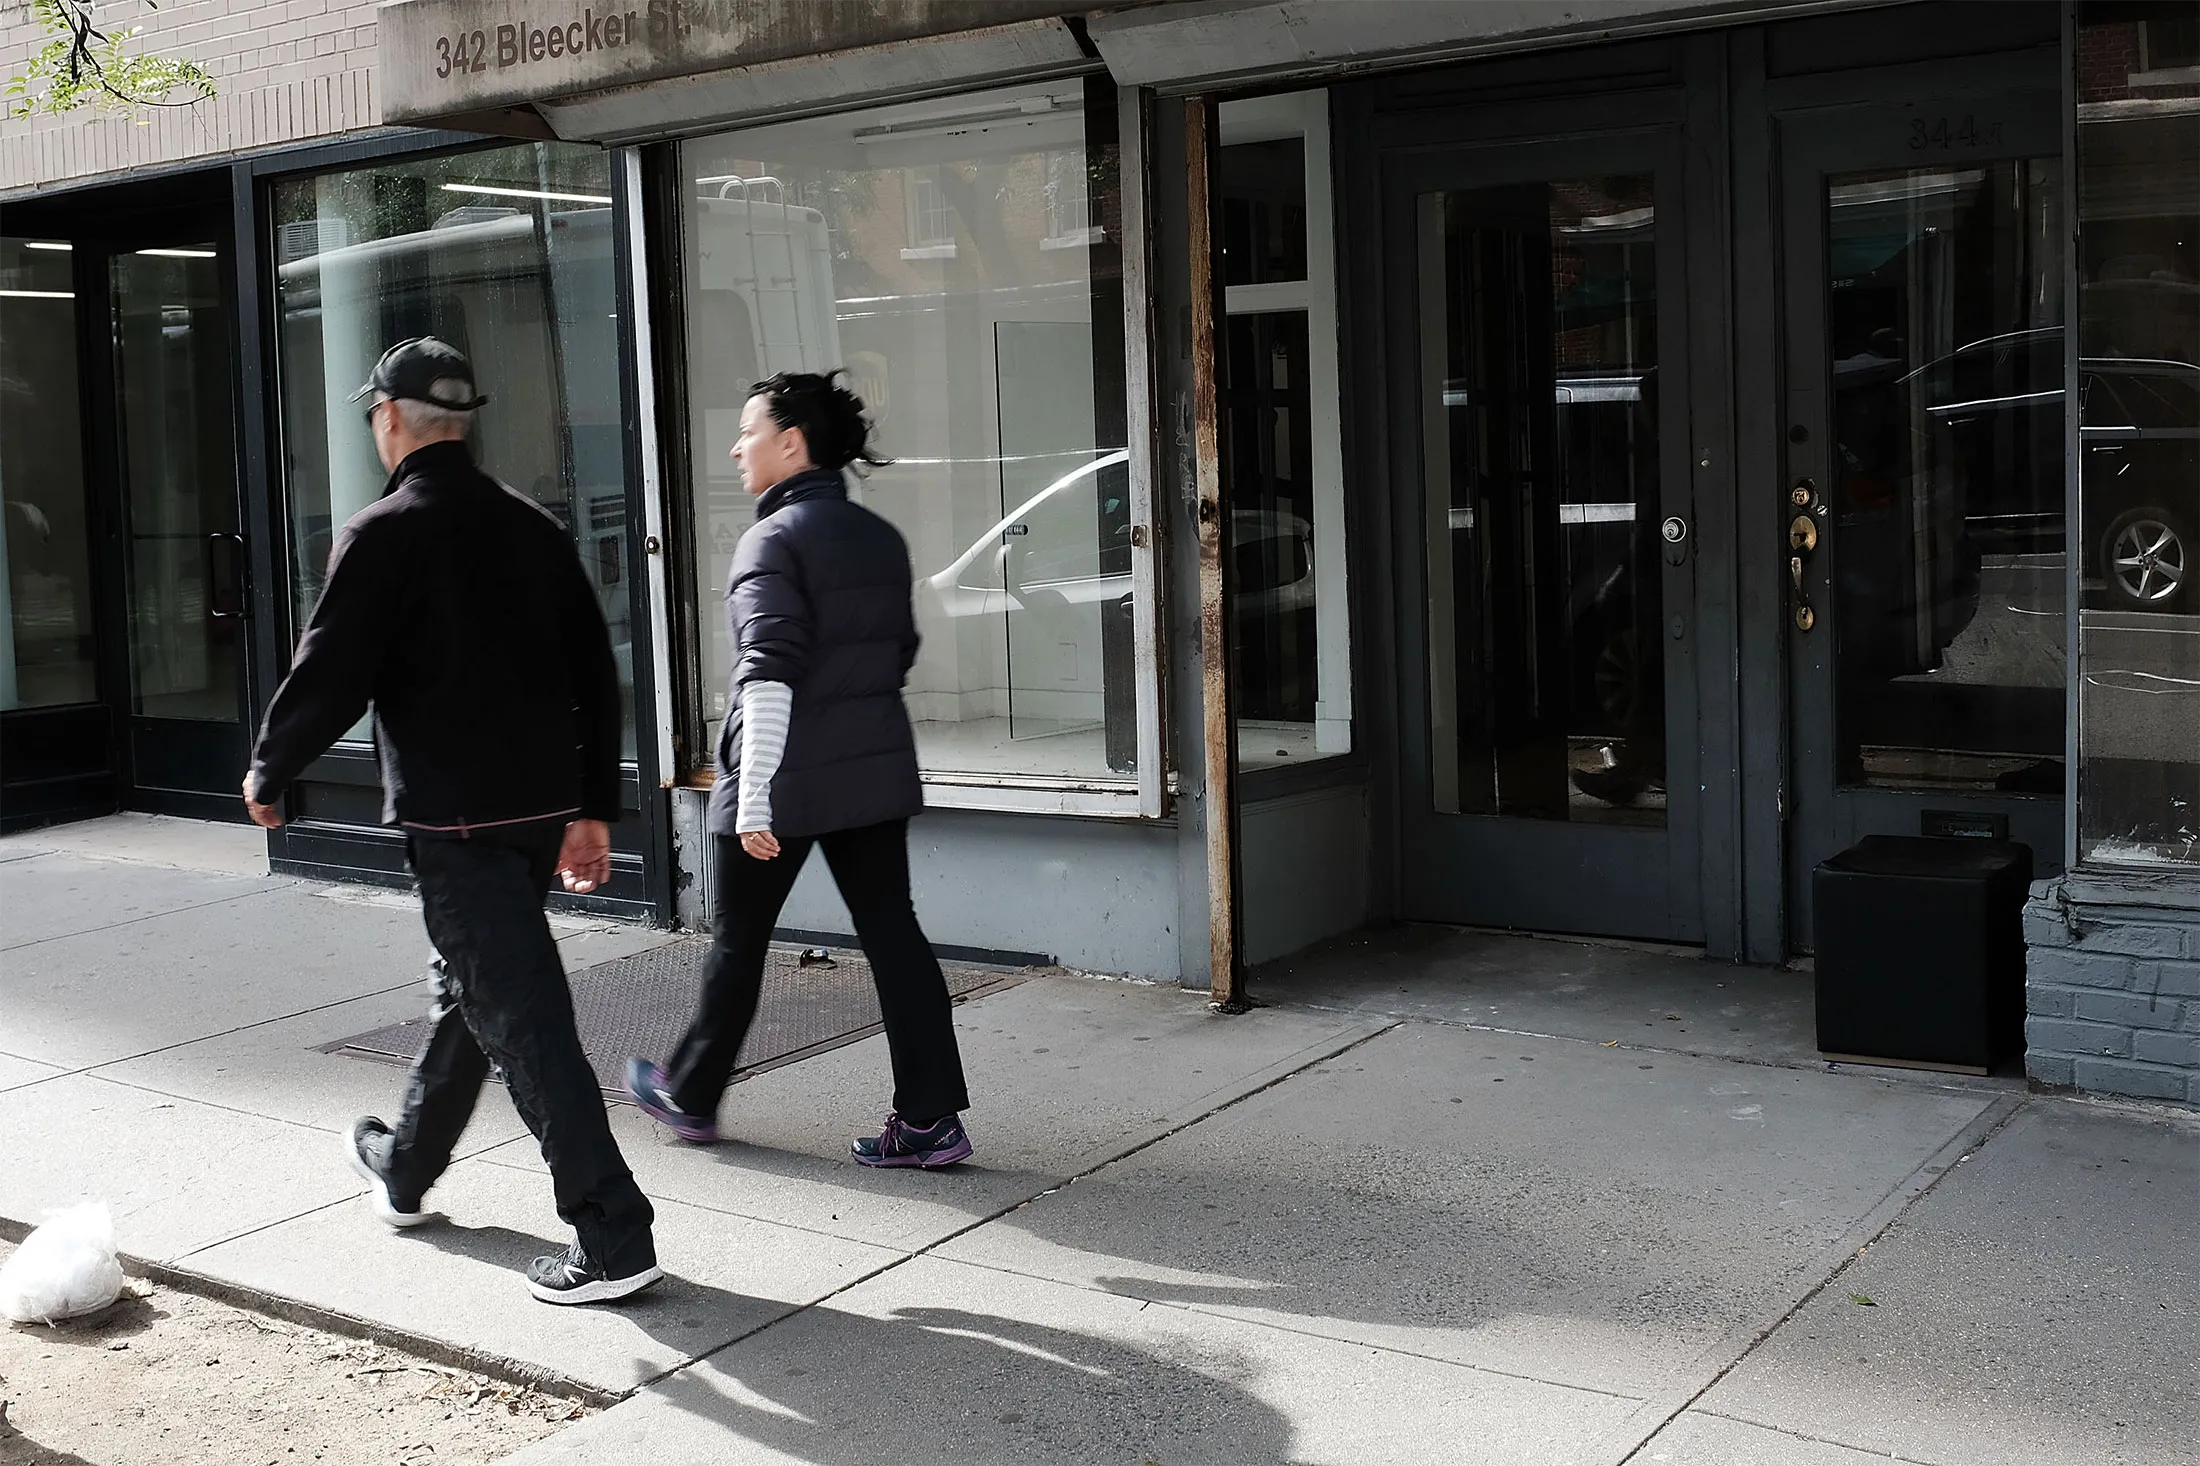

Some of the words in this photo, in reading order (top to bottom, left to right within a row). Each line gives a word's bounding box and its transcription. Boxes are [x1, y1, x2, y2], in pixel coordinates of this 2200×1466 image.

[435, 29, 487, 79] 342
[496, 8, 637, 68] Bleecker
[648, 0, 692, 39] St.
